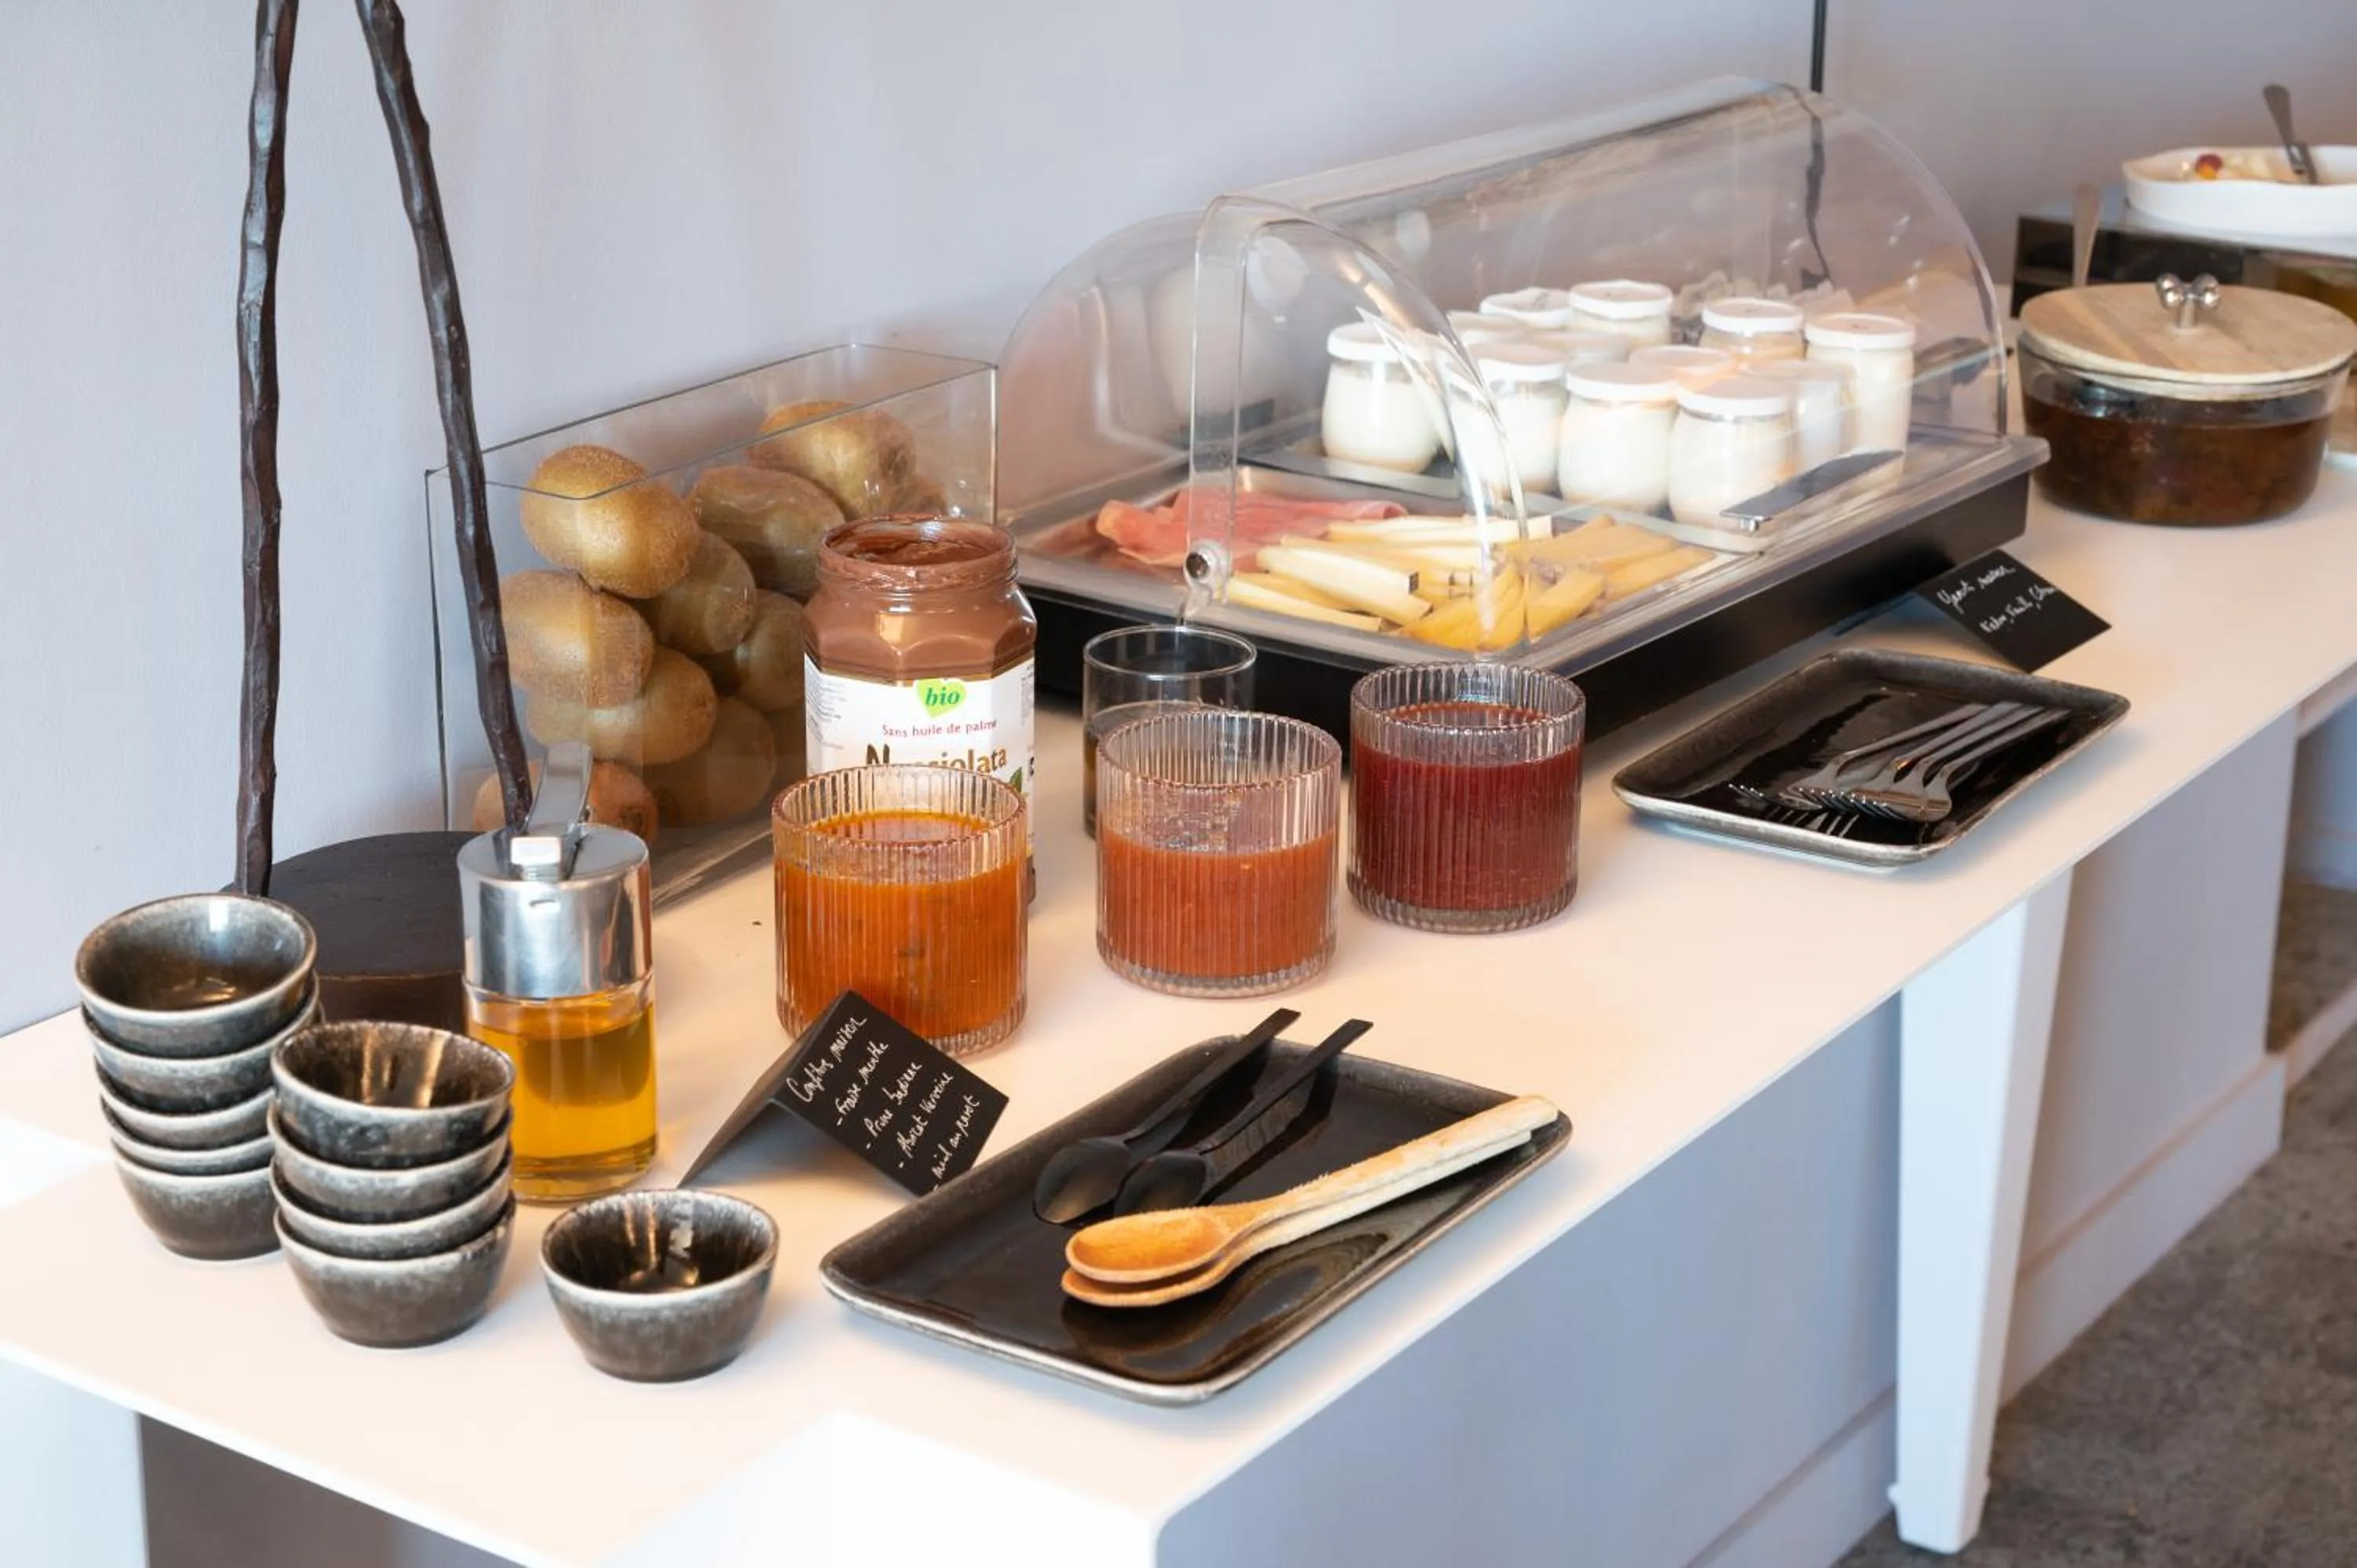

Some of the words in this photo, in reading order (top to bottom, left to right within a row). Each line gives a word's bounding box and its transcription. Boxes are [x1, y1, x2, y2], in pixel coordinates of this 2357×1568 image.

[926, 687, 960, 706] bio
[882, 724, 907, 738] Sans
[912, 724, 942, 737] huile
[947, 721, 961, 734] de
[966, 719, 998, 734] palme
